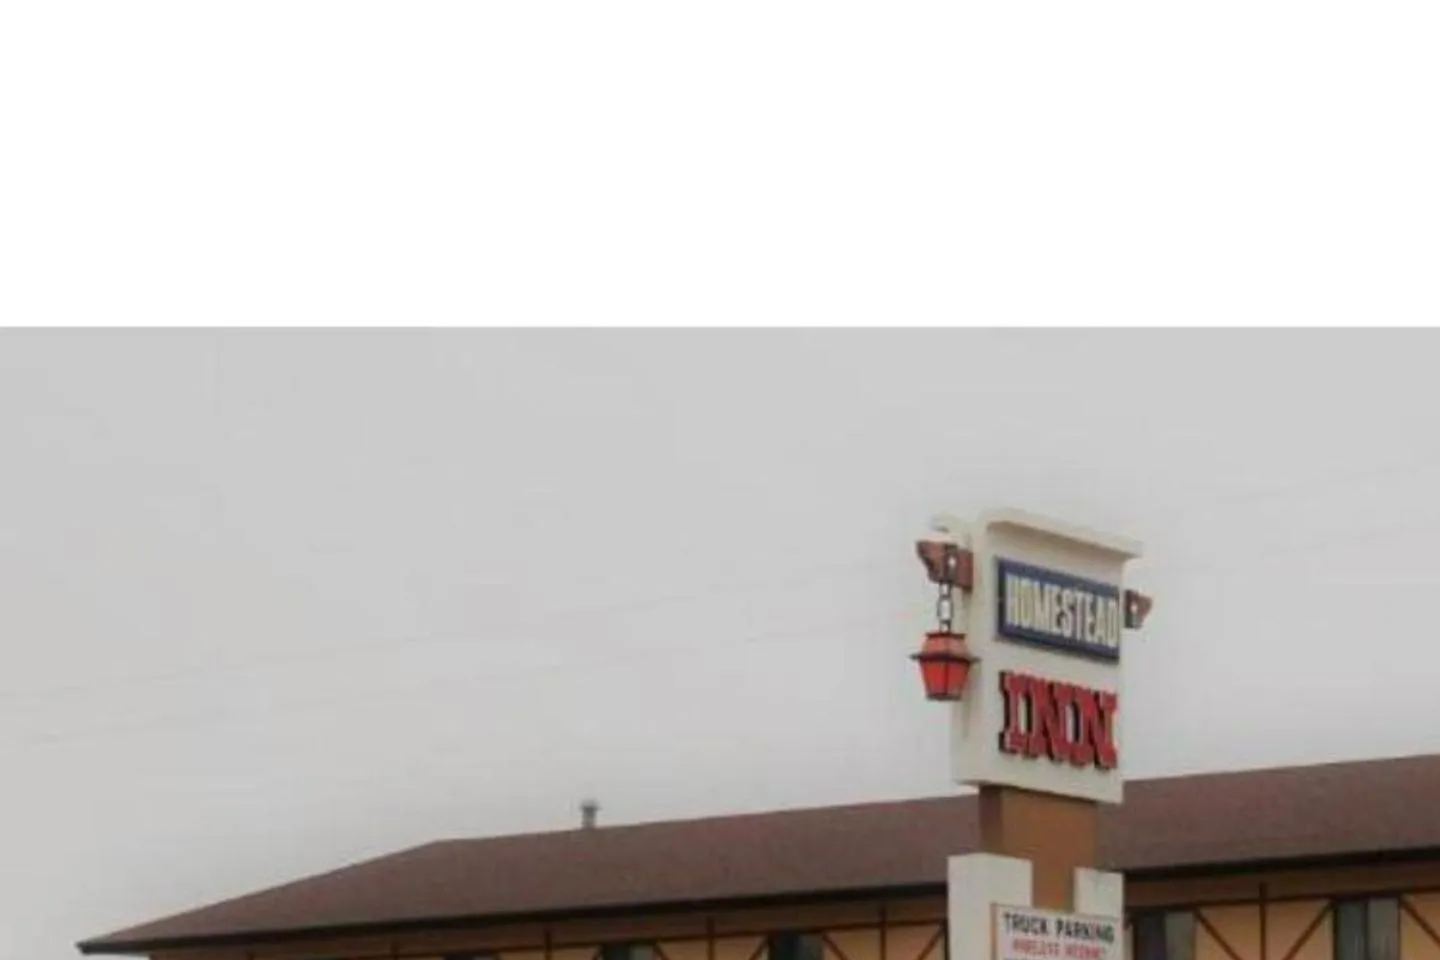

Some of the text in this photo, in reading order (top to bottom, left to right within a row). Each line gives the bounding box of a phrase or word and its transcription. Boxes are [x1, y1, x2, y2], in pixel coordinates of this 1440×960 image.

[1004, 572, 1118, 648] HOMESTEAD
[998, 670, 1117, 770] INN
[1003, 911, 1115, 943] TRUCK PARKING
